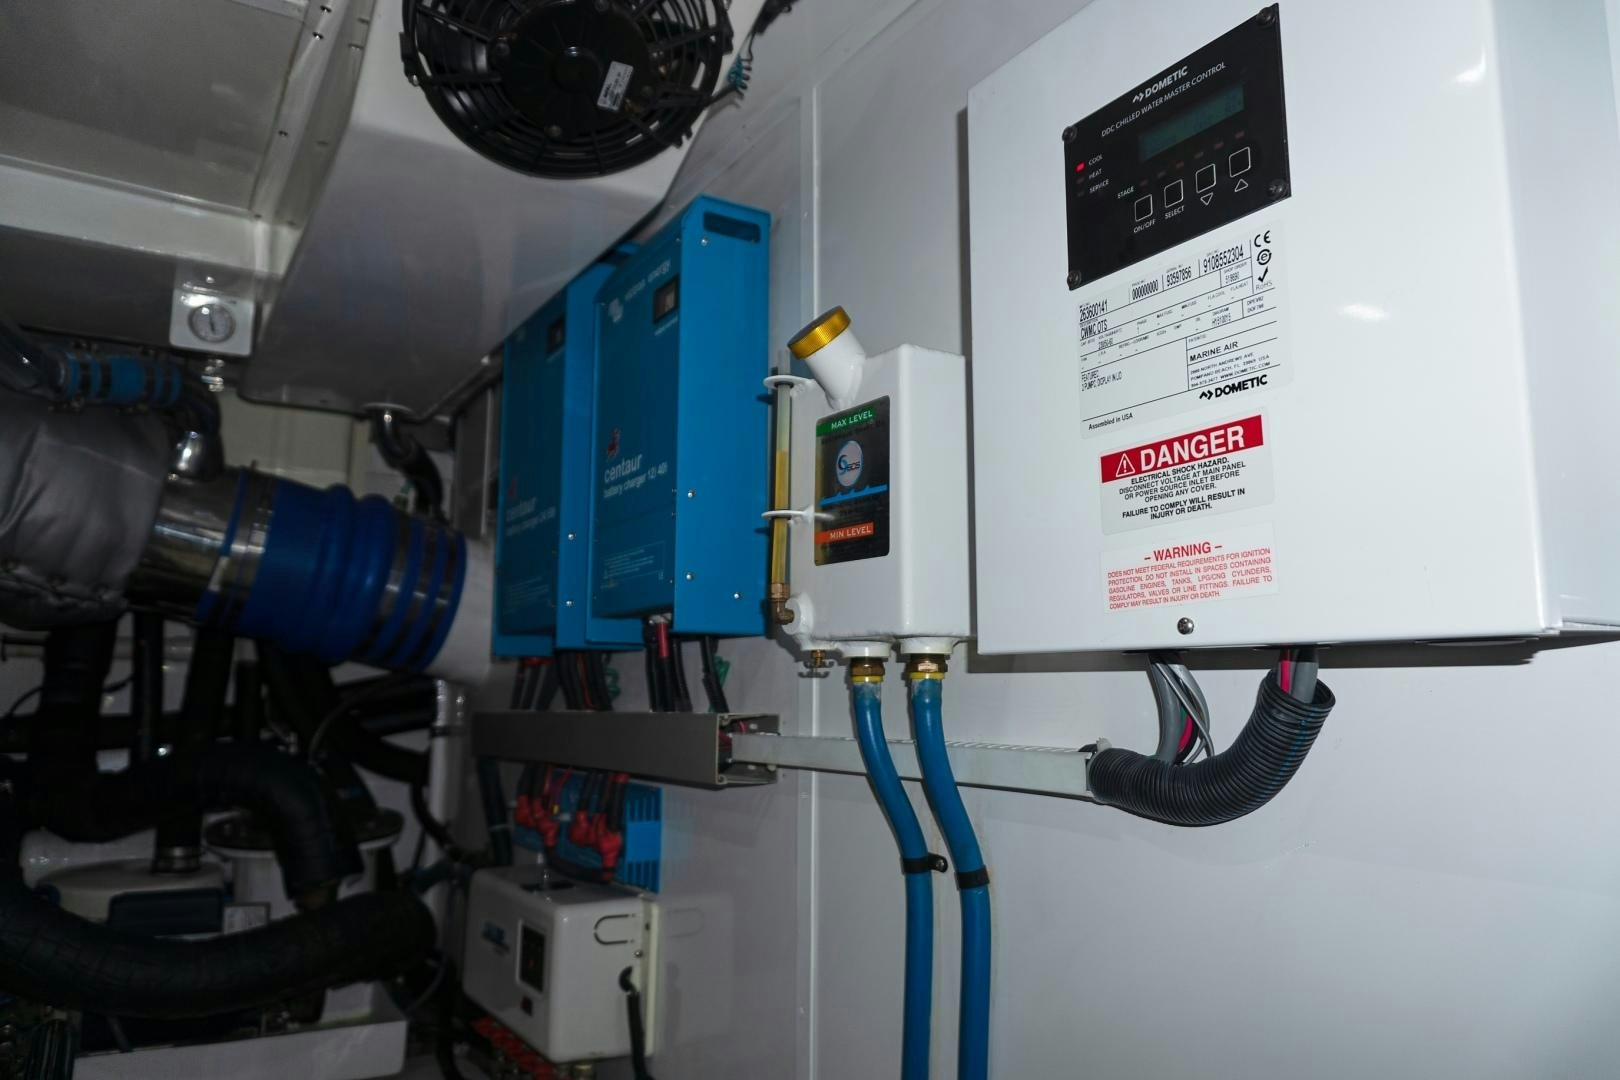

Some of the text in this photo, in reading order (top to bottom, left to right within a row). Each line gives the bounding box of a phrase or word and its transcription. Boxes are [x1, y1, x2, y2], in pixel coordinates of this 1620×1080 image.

[1145, 66, 1188, 98] DOMETIC
[1101, 61, 1226, 137] DDC CHILLED WATER MASTER CONTROL
[1089, 179, 1109, 194] SERVICE
[1117, 186, 1134, 199] STAGE
[1164, 205, 1185, 219] SELECT
[1133, 219, 1156, 234] ON/OFF
[1190, 341, 1239, 361] MARINE AIR
[1215, 374, 1268, 398] DOMETIC
[830, 410, 873, 430] MAX LEVEL
[1088, 417, 1115, 430] Assembled
[1121, 412, 1133, 421] USA
[1140, 425, 1245, 472] DANGER
[604, 454, 643, 483] centaur
[1119, 480, 1159, 495] DISCONNECT
[1160, 473, 1191, 485] VOLTAGE
[1202, 467, 1220, 476] MAIN
[1222, 461, 1246, 471] PANEL
[1131, 456, 1229, 485] ELECTRICAL SHOCK HAZARD.
[1135, 487, 1158, 498] POWER
[1160, 482, 1189, 493] SOURCE
[1188, 476, 1209, 486] INLET
[1210, 469, 1240, 482] BEFORE
[1144, 482, 1217, 502] OPENING ANY COVER.
[1122, 507, 1148, 518] FAILURE
[1149, 505, 1159, 513] TO
[1160, 499, 1188, 511] COMPLY
[1188, 495, 1206, 505] WILL
[1207, 489, 1236, 502] RESULT
[1150, 502, 1213, 520] INJURY OR DEATH.
[829, 525, 872, 540] MIN LEVEL
[1154, 541, 1211, 561] WARNING
[1108, 570, 1122, 579] DOES
[1135, 566, 1150, 574] MEET
[1150, 562, 1176, 572] FEDERAL
[1177, 554, 1225, 567] REQUIREMENTS
[1241, 547, 1270, 558] IGNITION
[1155, 571, 1168, 579] NOT
[1169, 568, 1193, 577] INSTALL
[1203, 563, 1228, 572] SPACES
[1229, 557, 1271, 569] CONTAINING
[1108, 585, 1135, 595] GASOLINE
[1148, 588, 1169, 597] VALVES
[1232, 577, 1260, 587] FAILURE
[1109, 602, 1130, 610] COMPLY
[1130, 599, 1143, 607] MAY
[1142, 598, 1163, 606] RESULT
[1169, 594, 1190, 602] INJURY
